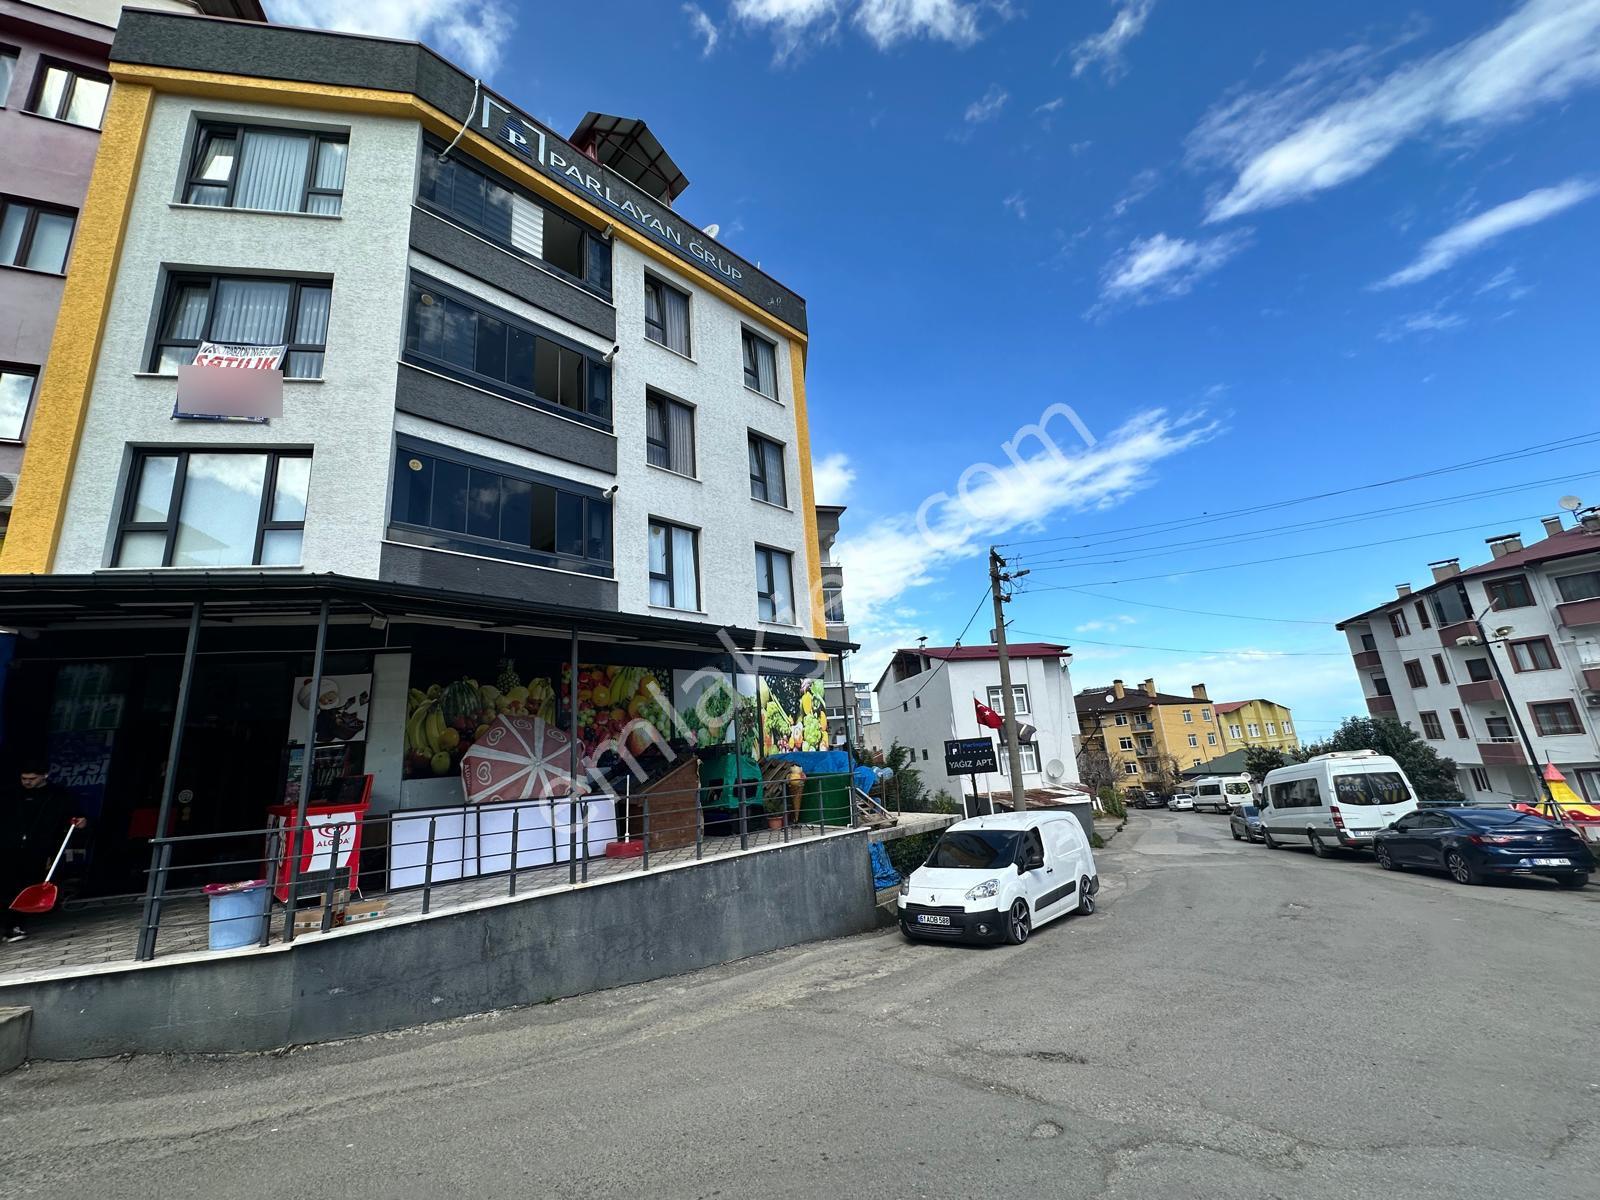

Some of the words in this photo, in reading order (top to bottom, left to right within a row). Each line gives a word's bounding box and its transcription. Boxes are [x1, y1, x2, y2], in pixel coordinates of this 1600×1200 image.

[550, 151, 681, 246] PARLAYAN
[688, 241, 743, 281] GRUP
[1339, 784, 1364, 792] OKUL
[316, 838, 349, 848] ALGDA
